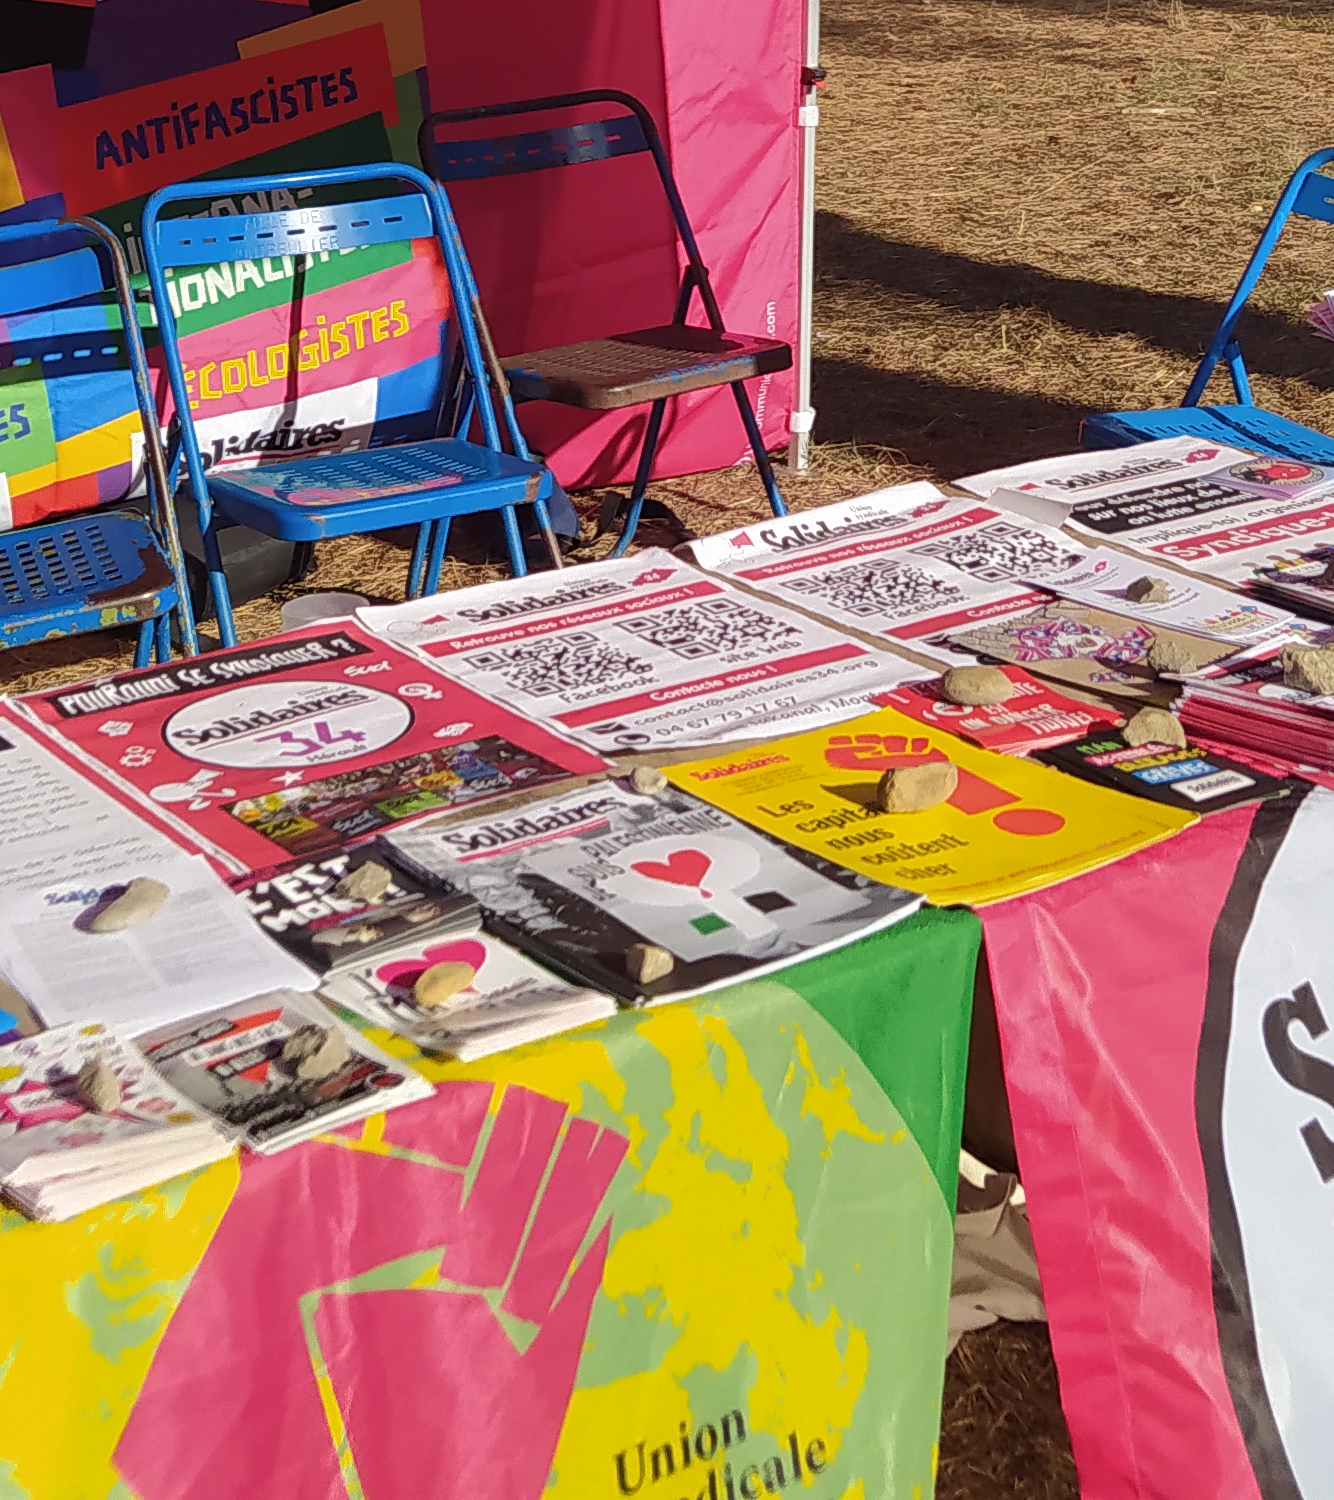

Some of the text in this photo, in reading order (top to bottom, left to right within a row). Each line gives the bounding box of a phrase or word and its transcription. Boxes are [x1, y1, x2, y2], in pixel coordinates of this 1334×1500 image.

[300, 210, 321, 224] DE
[1045, 458, 1183, 491] Solidaires
[1088, 509, 1117, 521] sur
[1121, 504, 1148, 517] nos
[760, 514, 908, 551] Solidaires
[448, 589, 685, 651] Retrouve nos réseaux sociaux
[458, 580, 625, 625] Solidaires
[178, 662, 213, 690] SE
[560, 674, 662, 704] Facebook
[649, 668, 767, 704] Contacte nous
[173, 687, 370, 748] Solidaires
[714, 710, 741, 725] 79
[745, 705, 770, 717] 17
[253, 721, 366, 758] 34
[441, 793, 628, 855] Solidaires
[754, 797, 816, 820] Les
[825, 825, 896, 854] nous
[861, 833, 969, 870] coûtent
[895, 860, 957, 883] cher
[613, 1408, 747, 1496] Union
[689, 1430, 828, 1500] dicale
